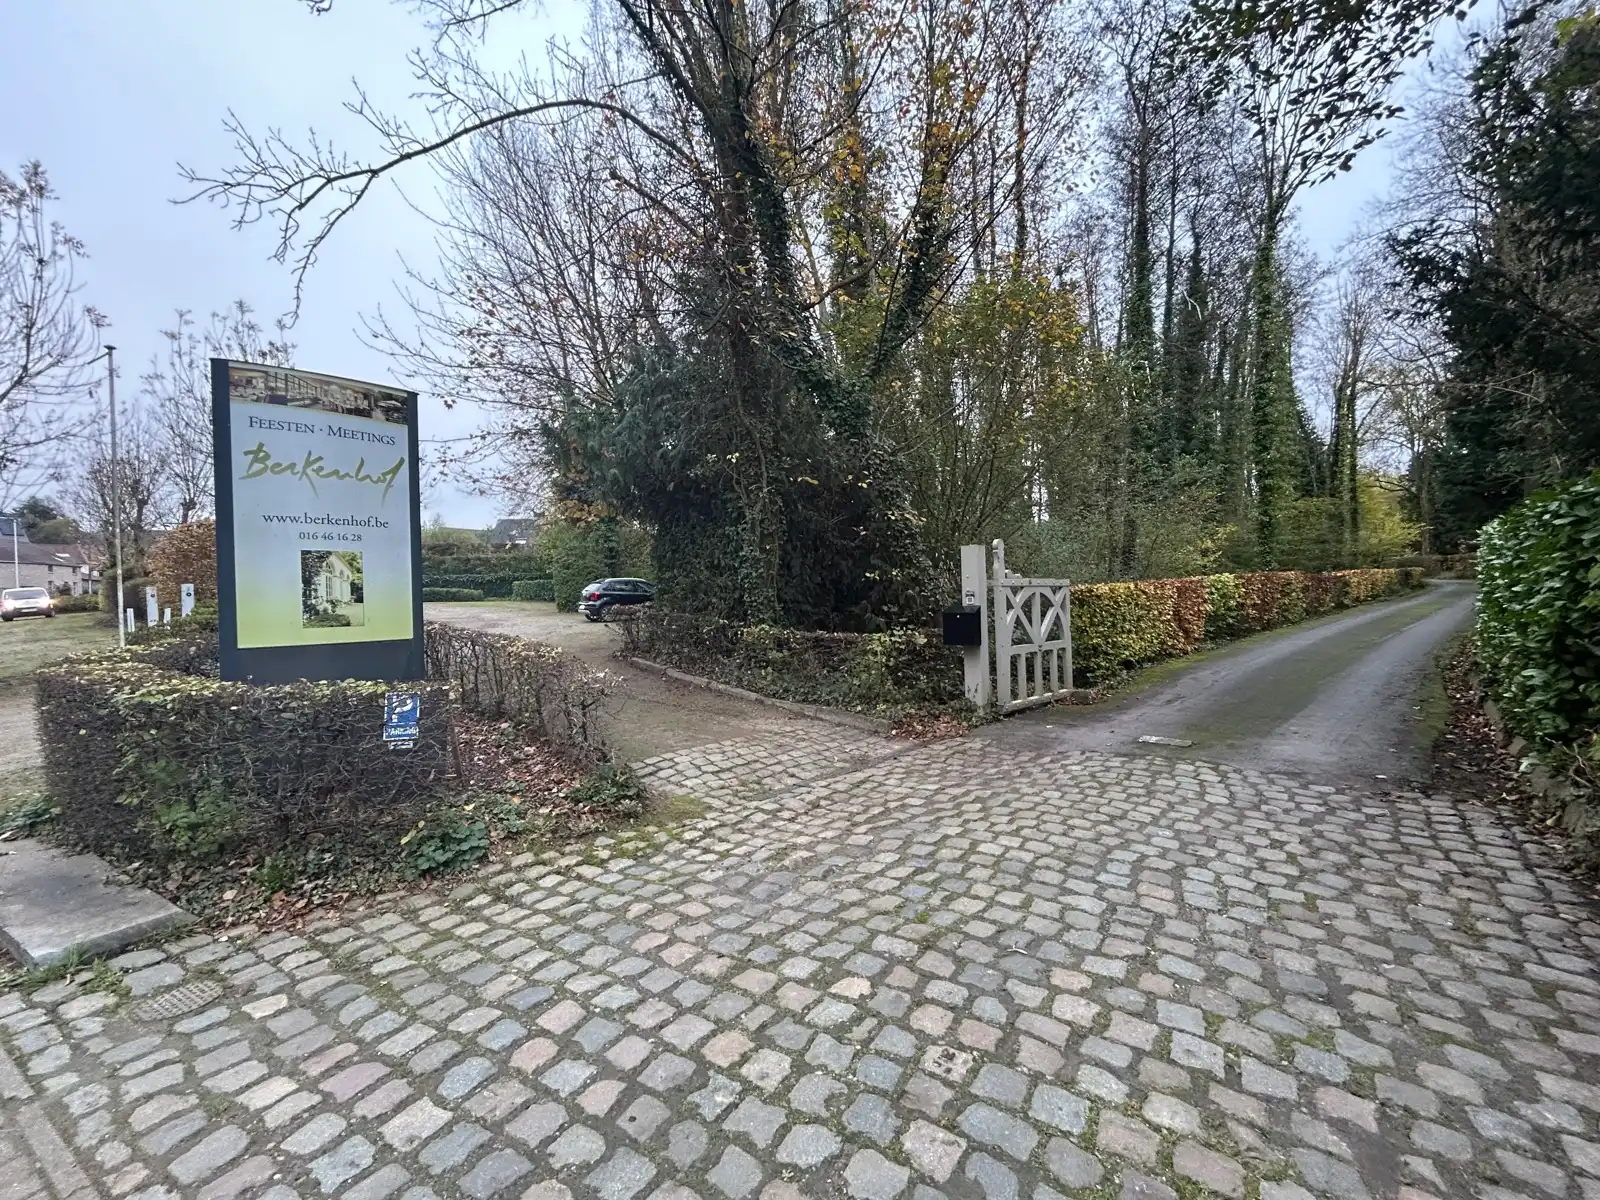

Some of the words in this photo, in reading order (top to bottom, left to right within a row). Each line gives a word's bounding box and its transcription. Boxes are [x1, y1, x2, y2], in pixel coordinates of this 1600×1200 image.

[248, 415, 315, 434] FEESTEN
[327, 425, 396, 446] MEETINGS
[261, 512, 389, 528] www.berkenhof.be
[299, 531, 319, 541] 016
[321, 532, 334, 541] 46
[337, 533, 349, 541] 16
[351, 533, 363, 542] 28
